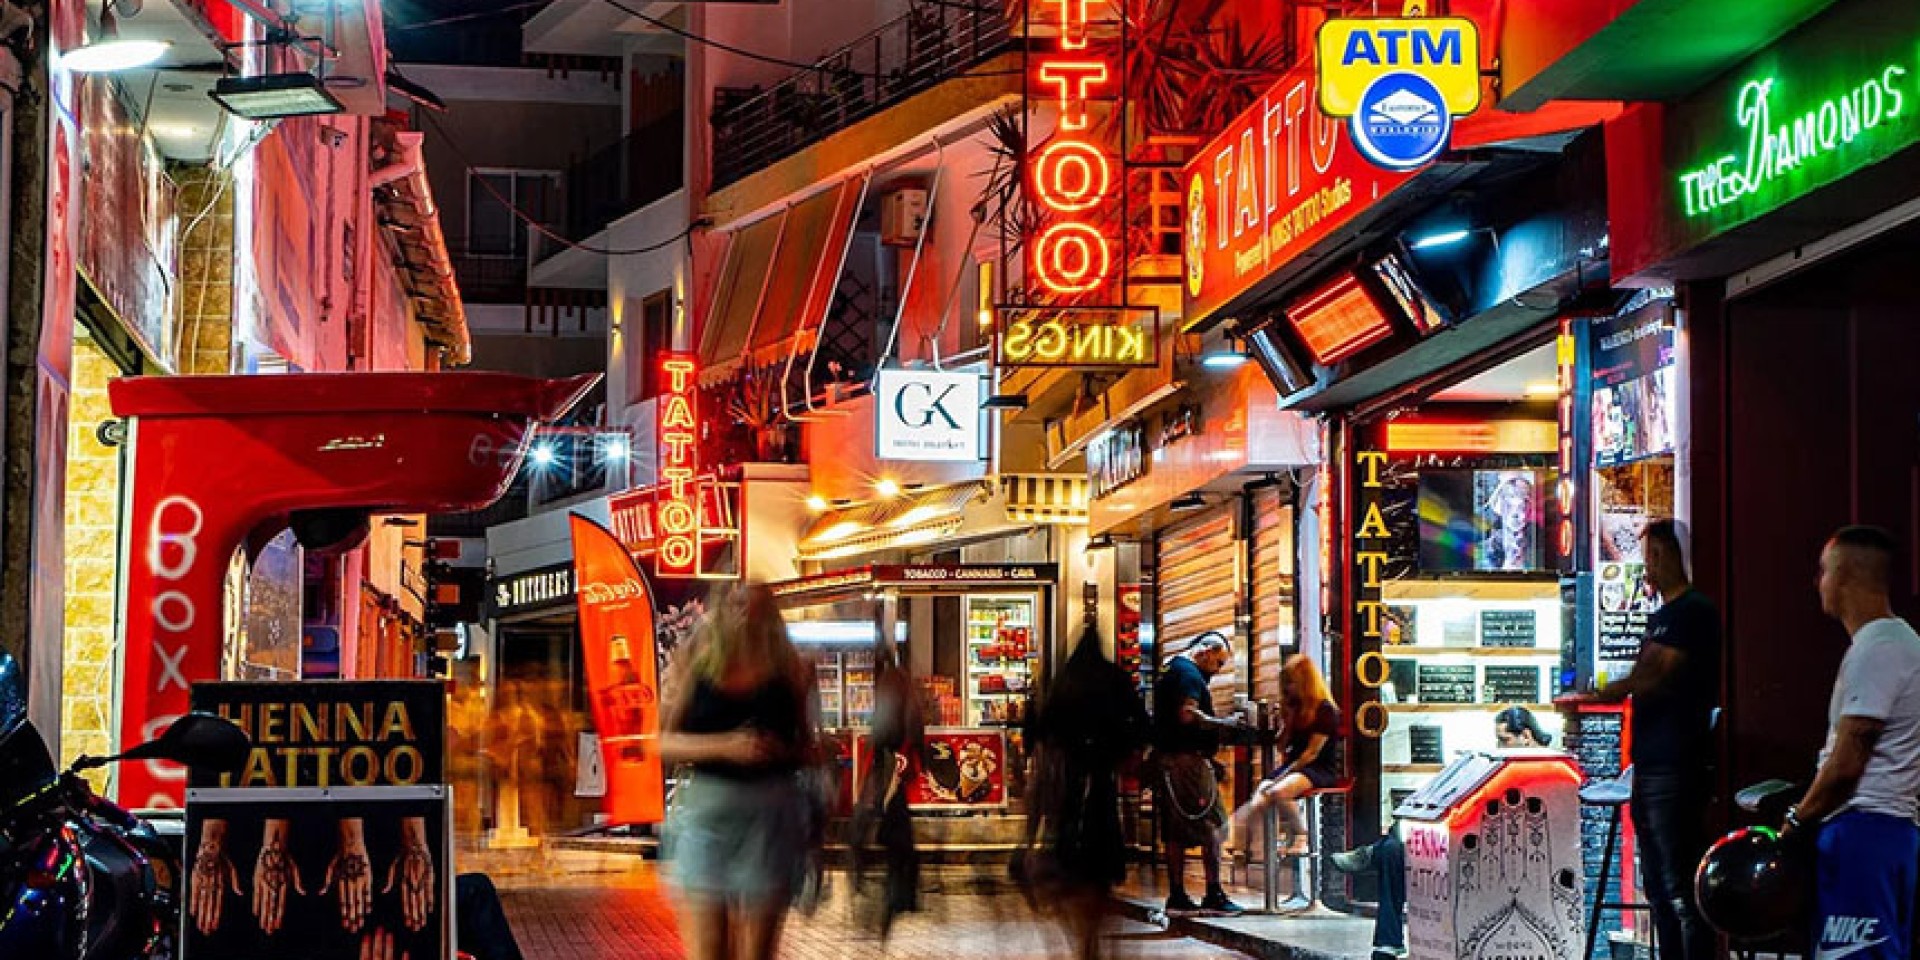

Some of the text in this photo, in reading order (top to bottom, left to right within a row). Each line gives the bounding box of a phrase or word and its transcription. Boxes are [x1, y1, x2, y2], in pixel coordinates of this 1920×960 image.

[1341, 29, 1462, 66] ATM
[894, 381, 966, 430] GK
[660, 361, 695, 567] TATTOO
[903, 568, 948, 580] TOBACCO
[955, 568, 1004, 580] CANNABIS
[1355, 451, 1391, 737] TATTOO
[219, 700, 417, 743] HENNA
[219, 745, 425, 788] ATTOO
[1406, 866, 1451, 902] TATTOO
[1822, 915, 1880, 943] NIKE
